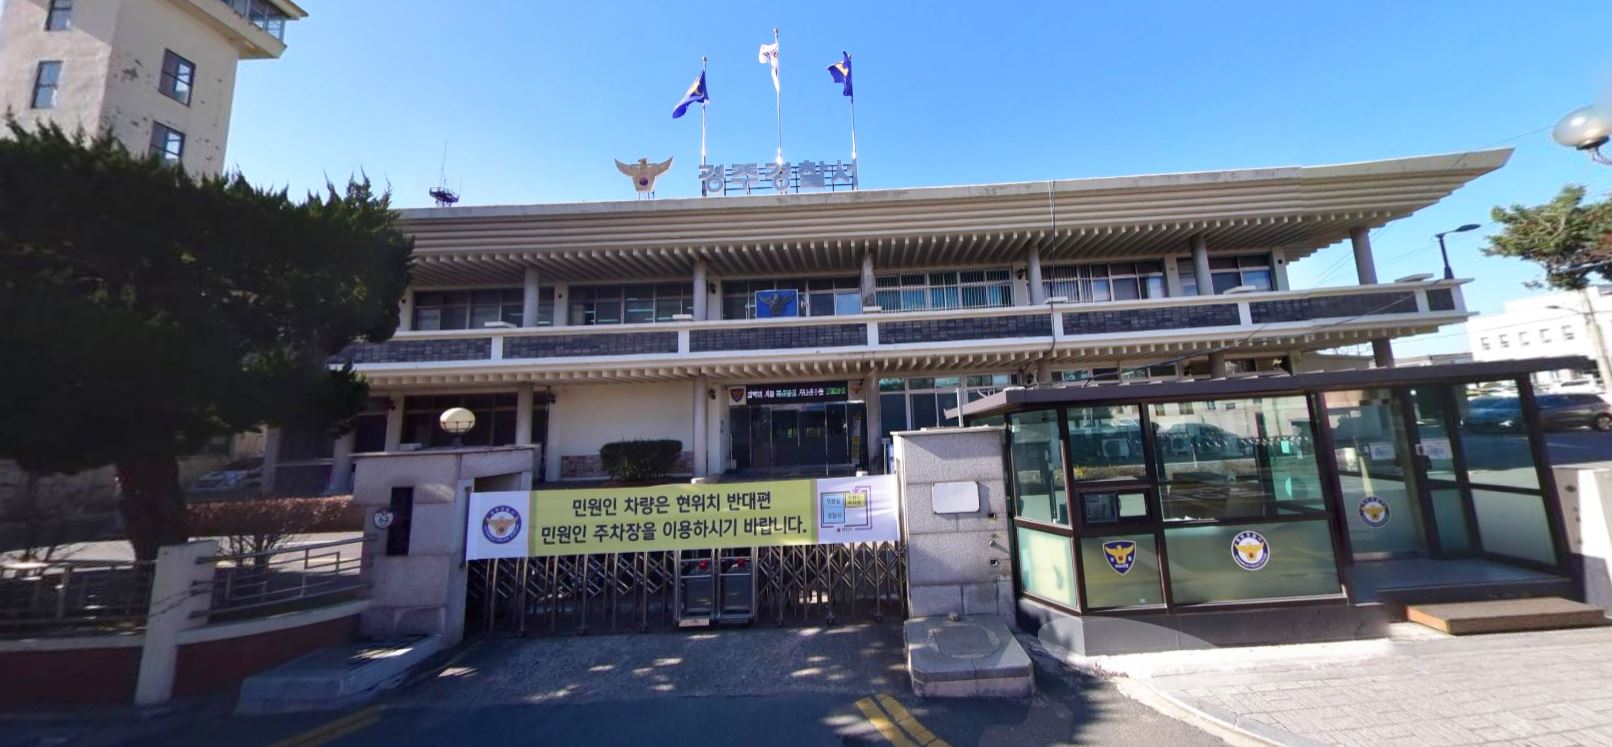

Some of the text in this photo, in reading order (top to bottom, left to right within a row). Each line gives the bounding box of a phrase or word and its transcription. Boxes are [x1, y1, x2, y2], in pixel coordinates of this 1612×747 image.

[699, 160, 858, 193] 경주경찰서
[573, 491, 771, 518] 민원인 차량은 현위치 반대편
[541, 525, 587, 545] 민원인
[593, 521, 657, 543] 주차장을
[663, 518, 737, 540] 이용하시기
[744, 515, 807, 537] 바랍니다.
